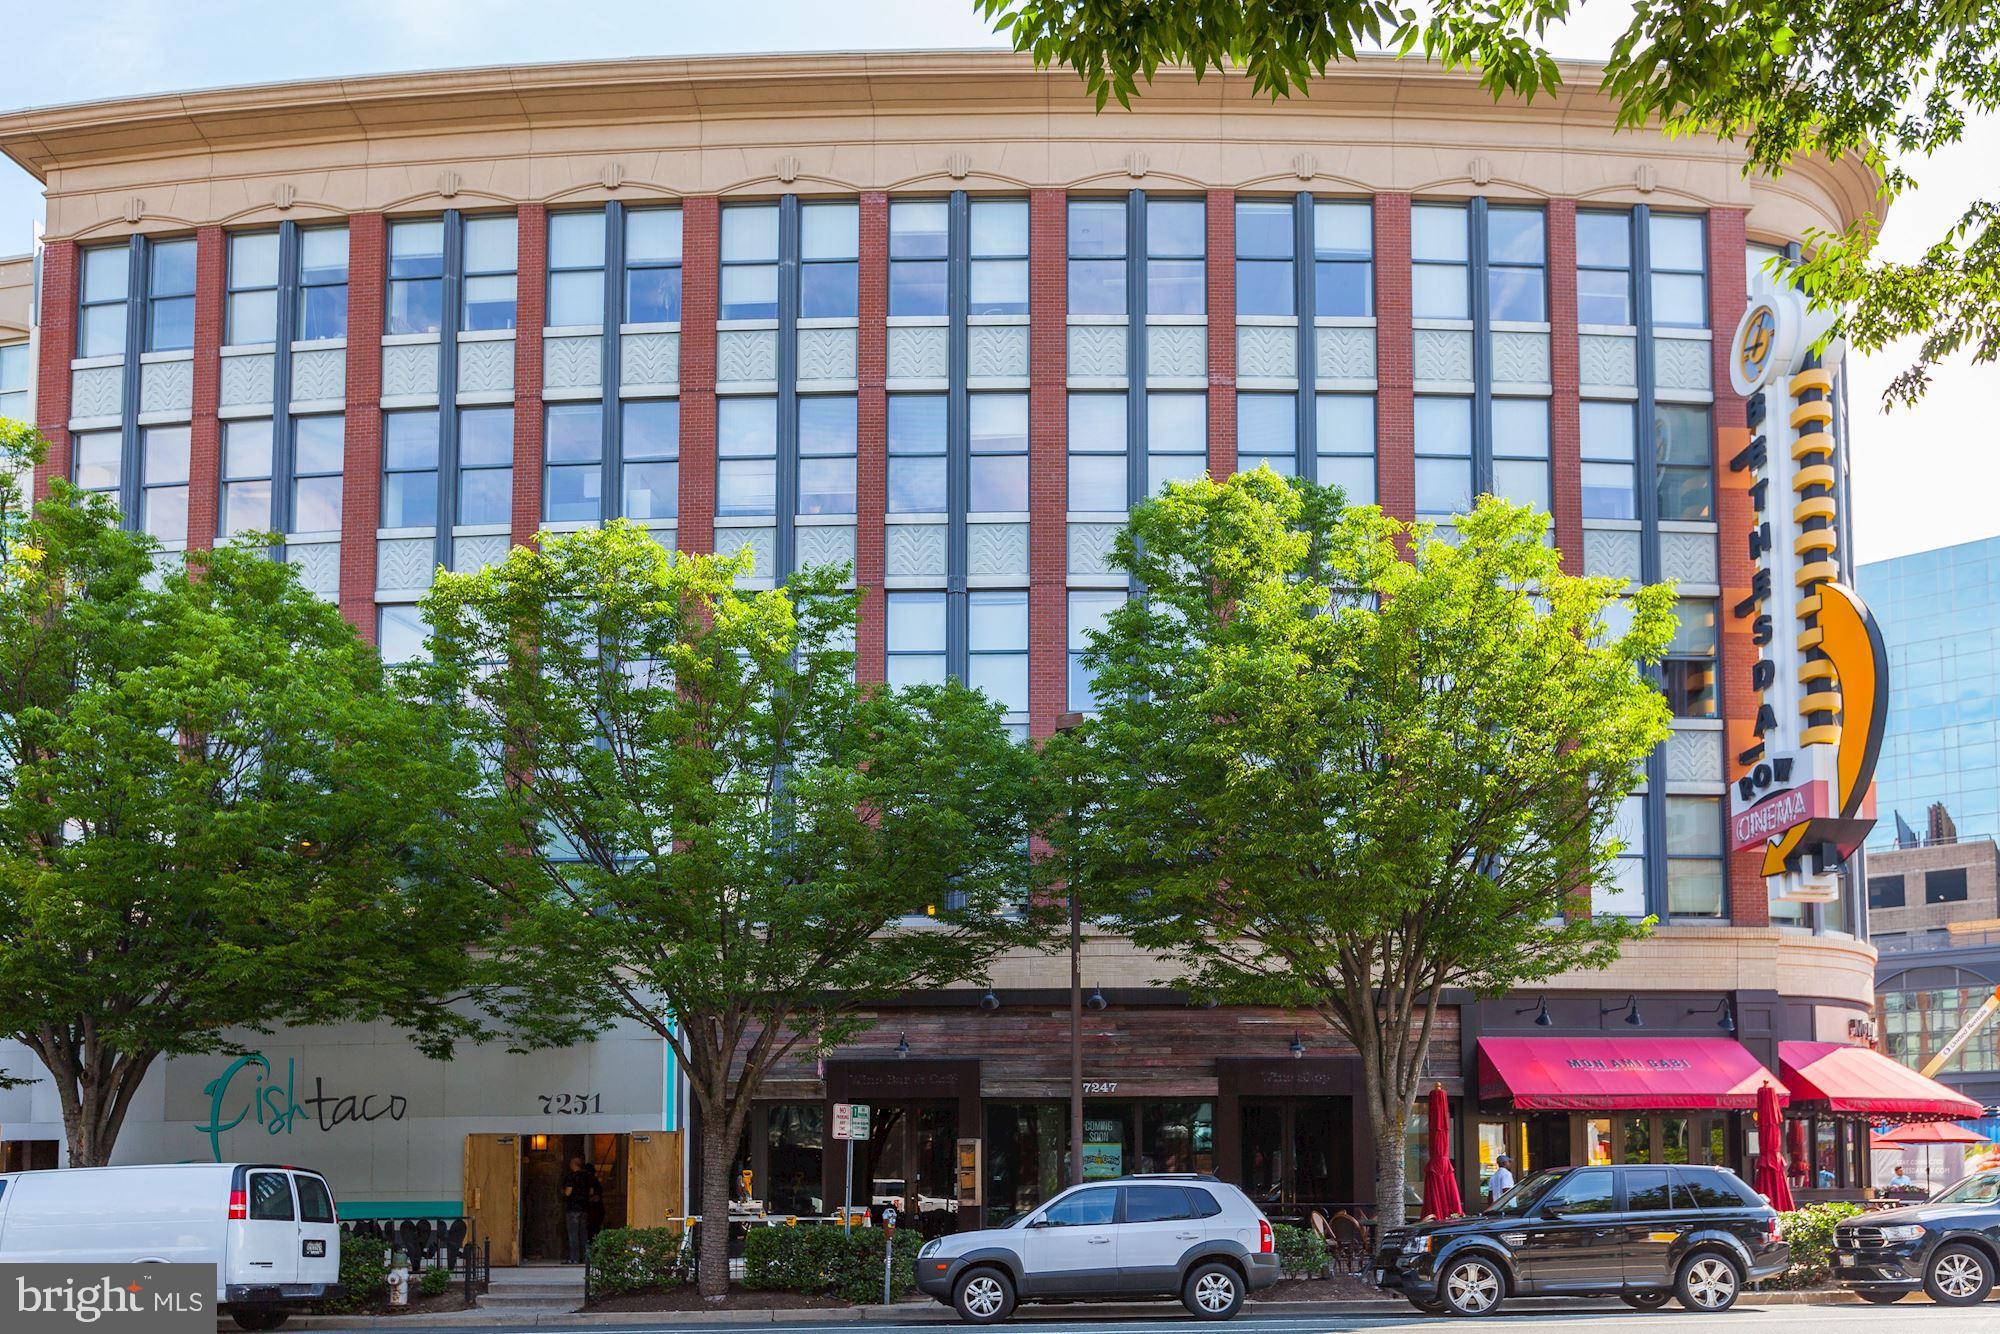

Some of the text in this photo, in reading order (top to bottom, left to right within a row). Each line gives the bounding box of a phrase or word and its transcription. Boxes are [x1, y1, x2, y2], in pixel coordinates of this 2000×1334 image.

[1739, 758, 1794, 802] ROW
[1737, 791, 1807, 842] CINEMA
[1566, 1059, 1692, 1069] MON AMI GABI
[1082, 1083, 1118, 1093] 7247
[538, 1093, 605, 1115] 7251
[1085, 1121, 1113, 1131] COMING
[1089, 1131, 1109, 1142] SOON
